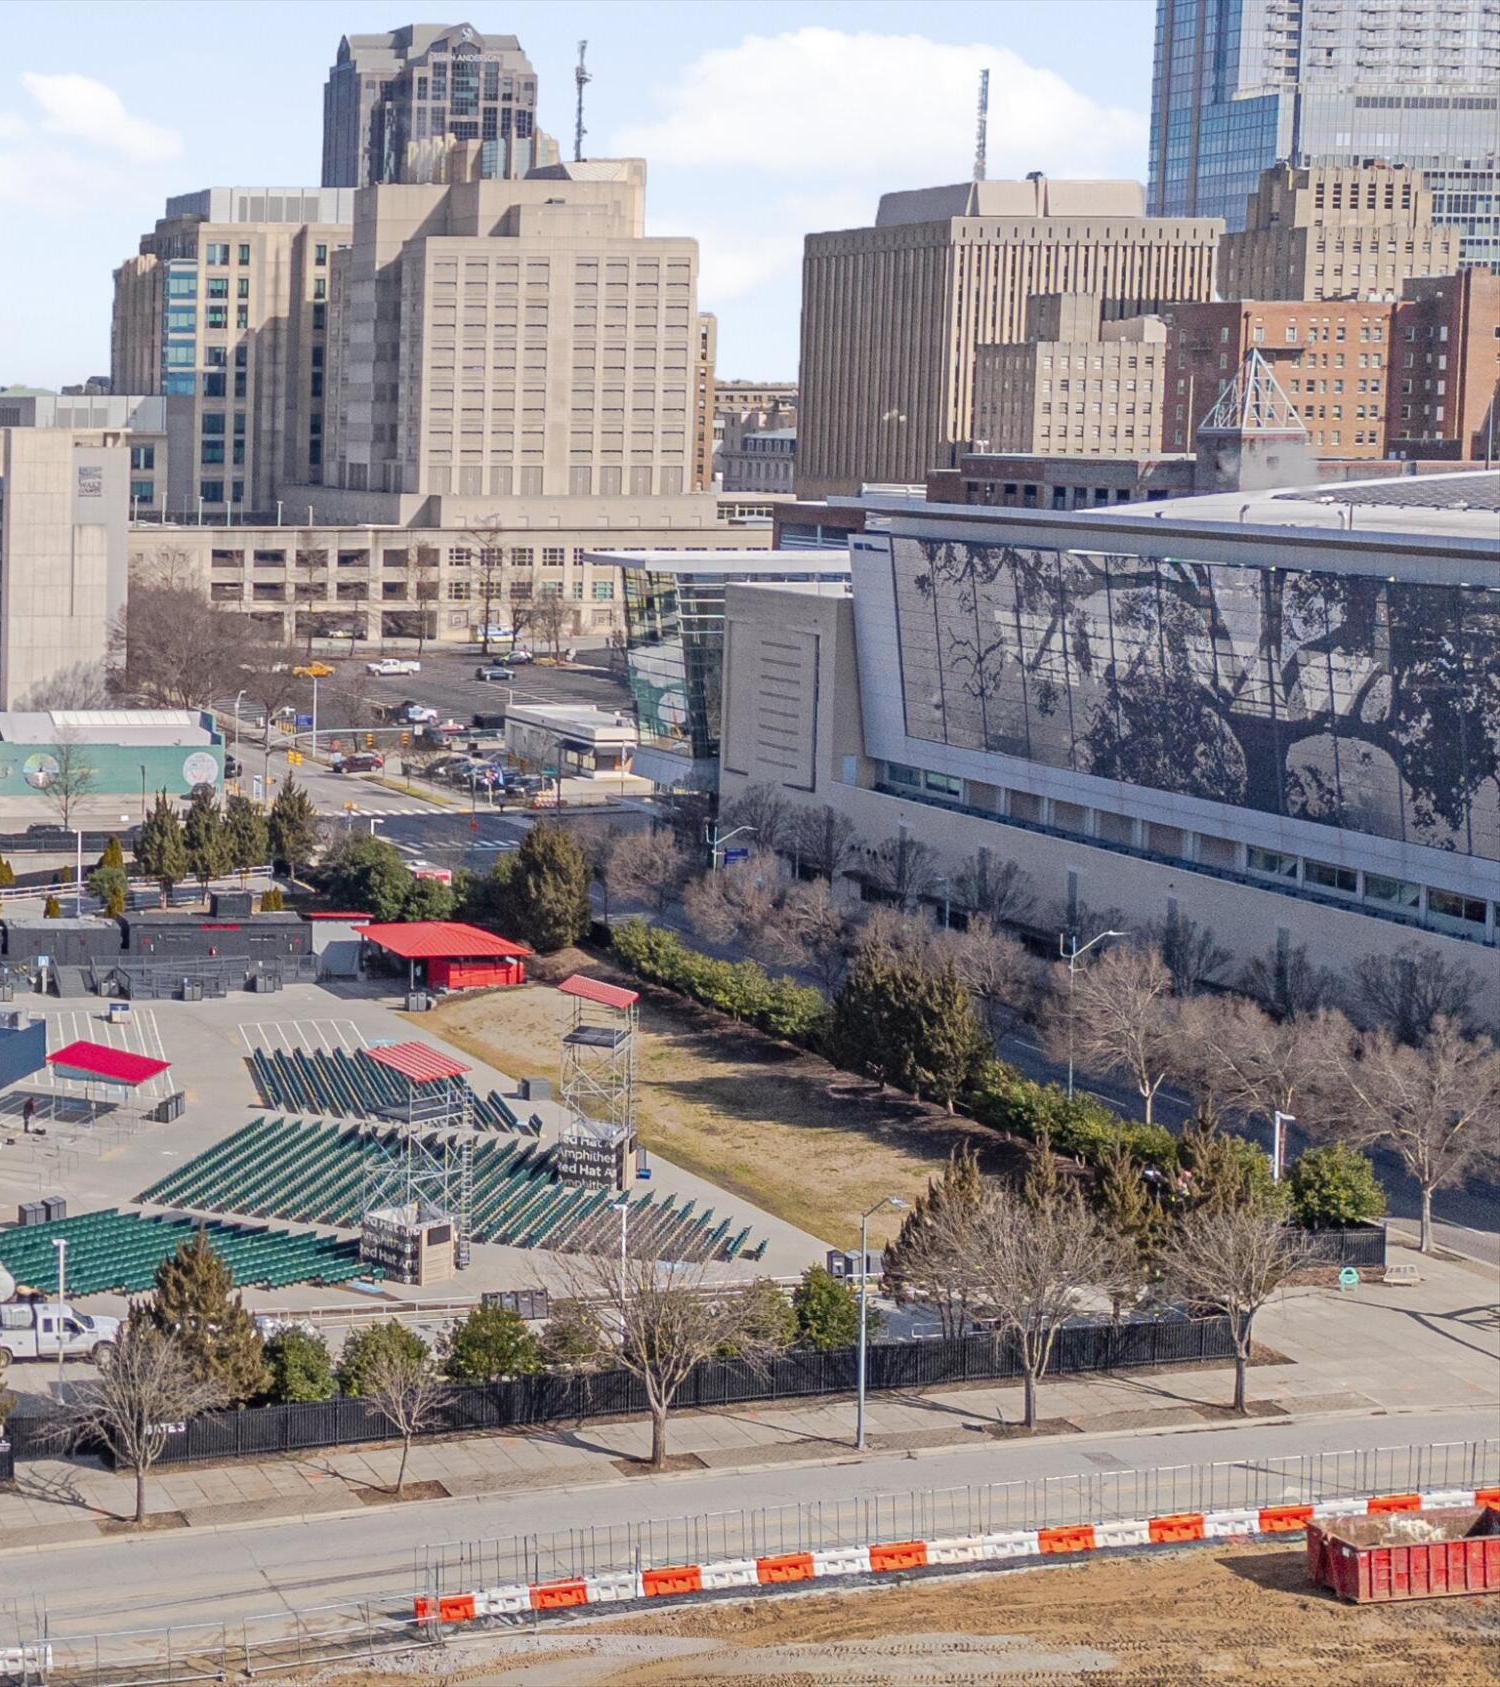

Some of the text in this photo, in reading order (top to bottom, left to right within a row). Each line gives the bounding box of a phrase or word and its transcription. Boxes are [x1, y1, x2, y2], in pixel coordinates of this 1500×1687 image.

[580, 1164, 602, 1177] Hat
[380, 1248, 399, 1266] Hat
[177, 1422, 186, 1432] 3
